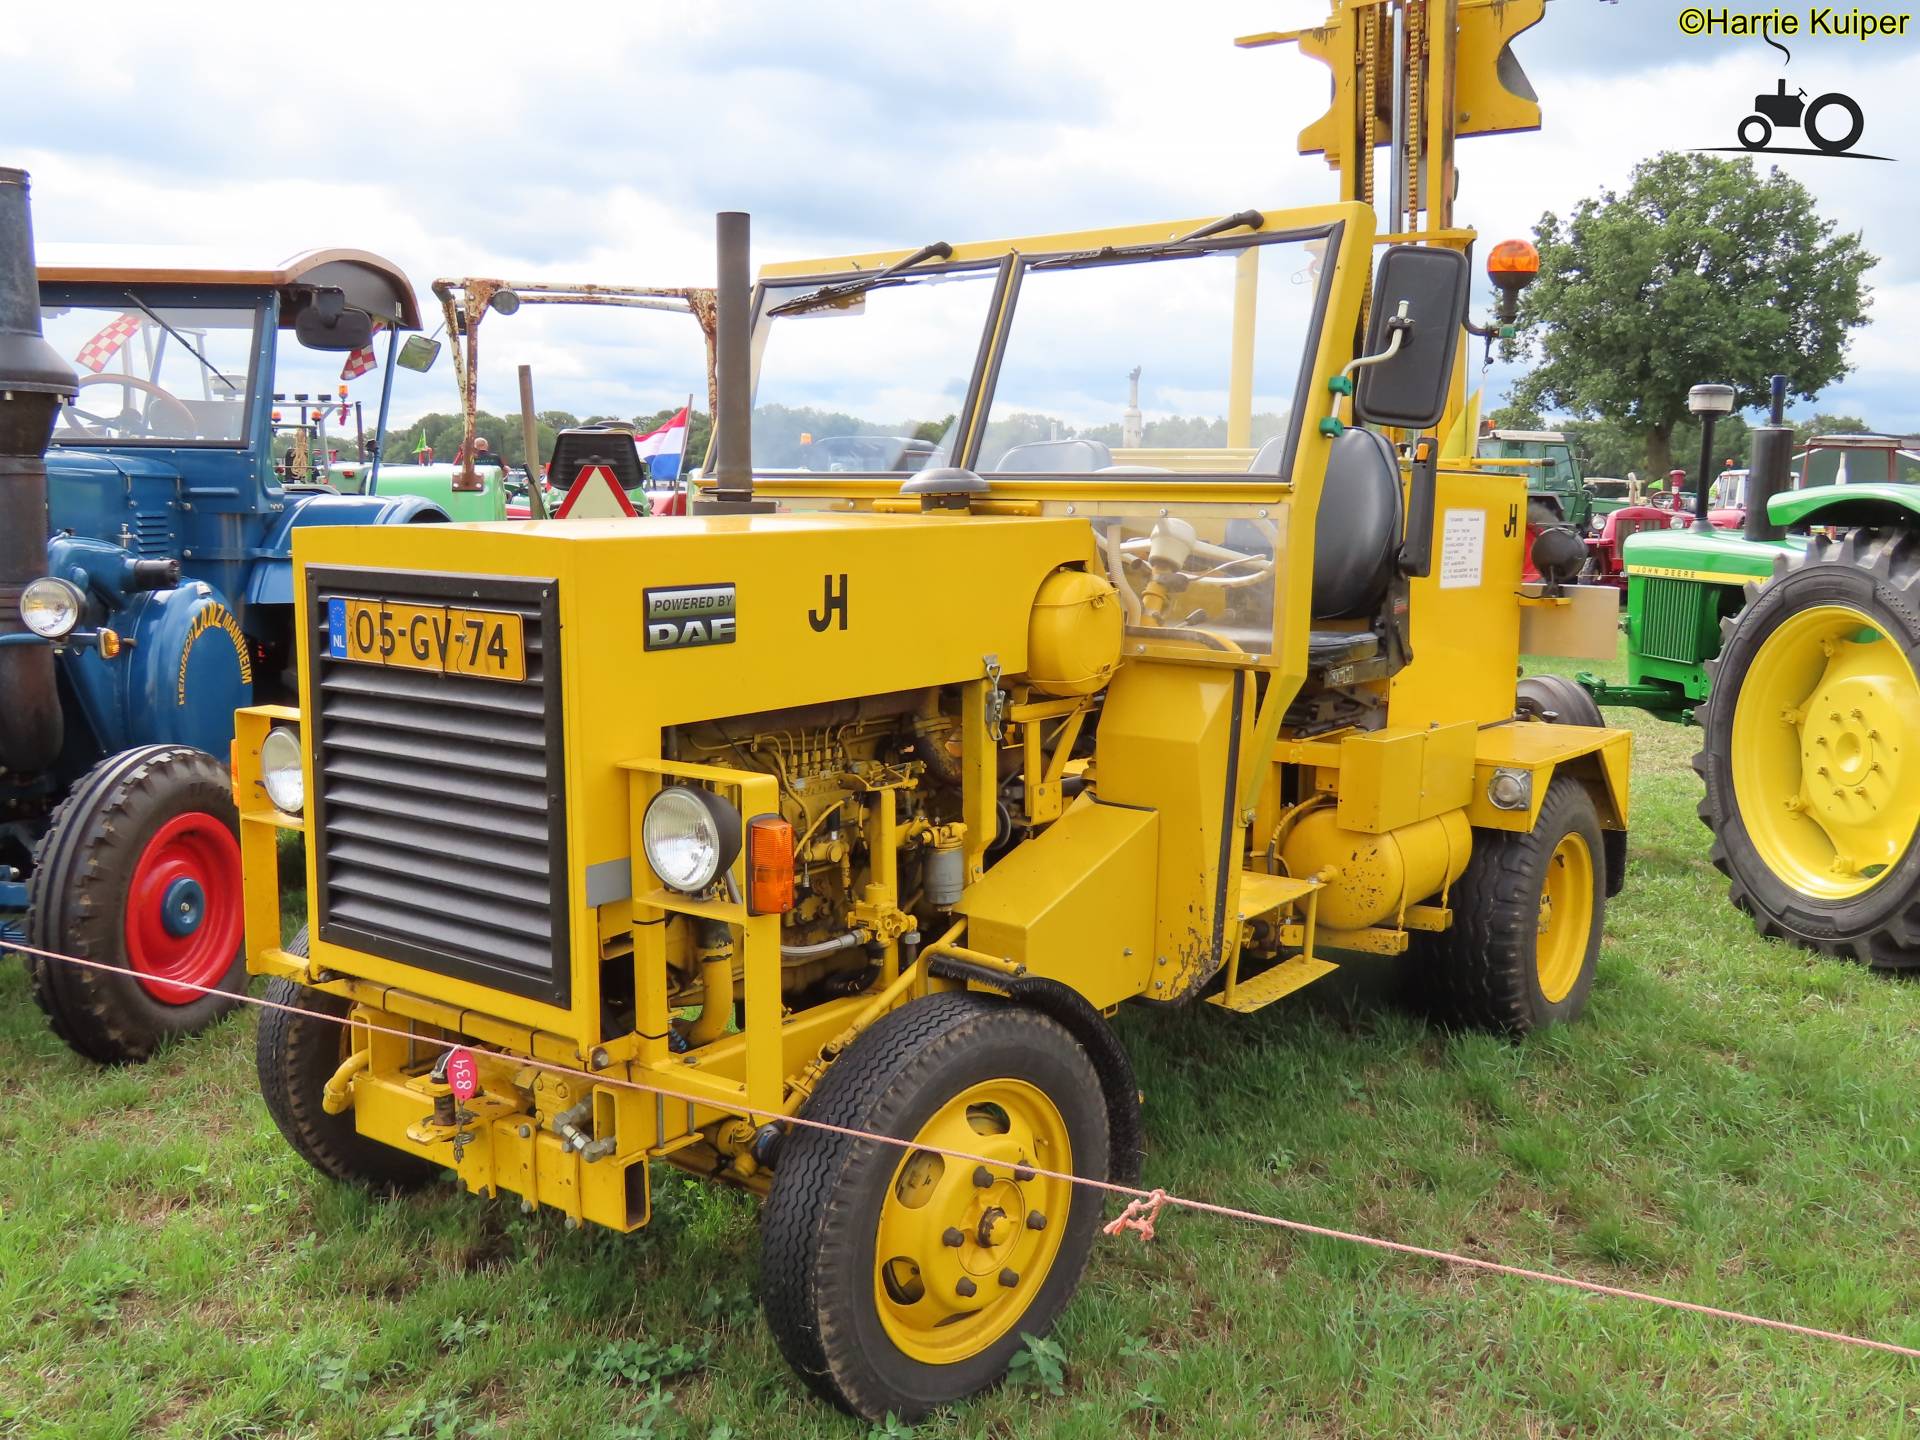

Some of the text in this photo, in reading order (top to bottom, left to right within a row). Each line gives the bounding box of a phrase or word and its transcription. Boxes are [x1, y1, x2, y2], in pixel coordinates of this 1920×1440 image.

[1503, 503, 1518, 538] JH
[1635, 565, 1696, 579] JOHN DEERE
[653, 594, 734, 613] POWERED BY
[807, 573, 848, 633] JH
[332, 634, 345, 648] NL
[355, 608, 508, 670] 05-GV-74
[648, 617, 736, 647] DAF
[178, 601, 253, 706] HEINRICH LANZ MANNHEIM
[452, 1058, 473, 1091] 834
